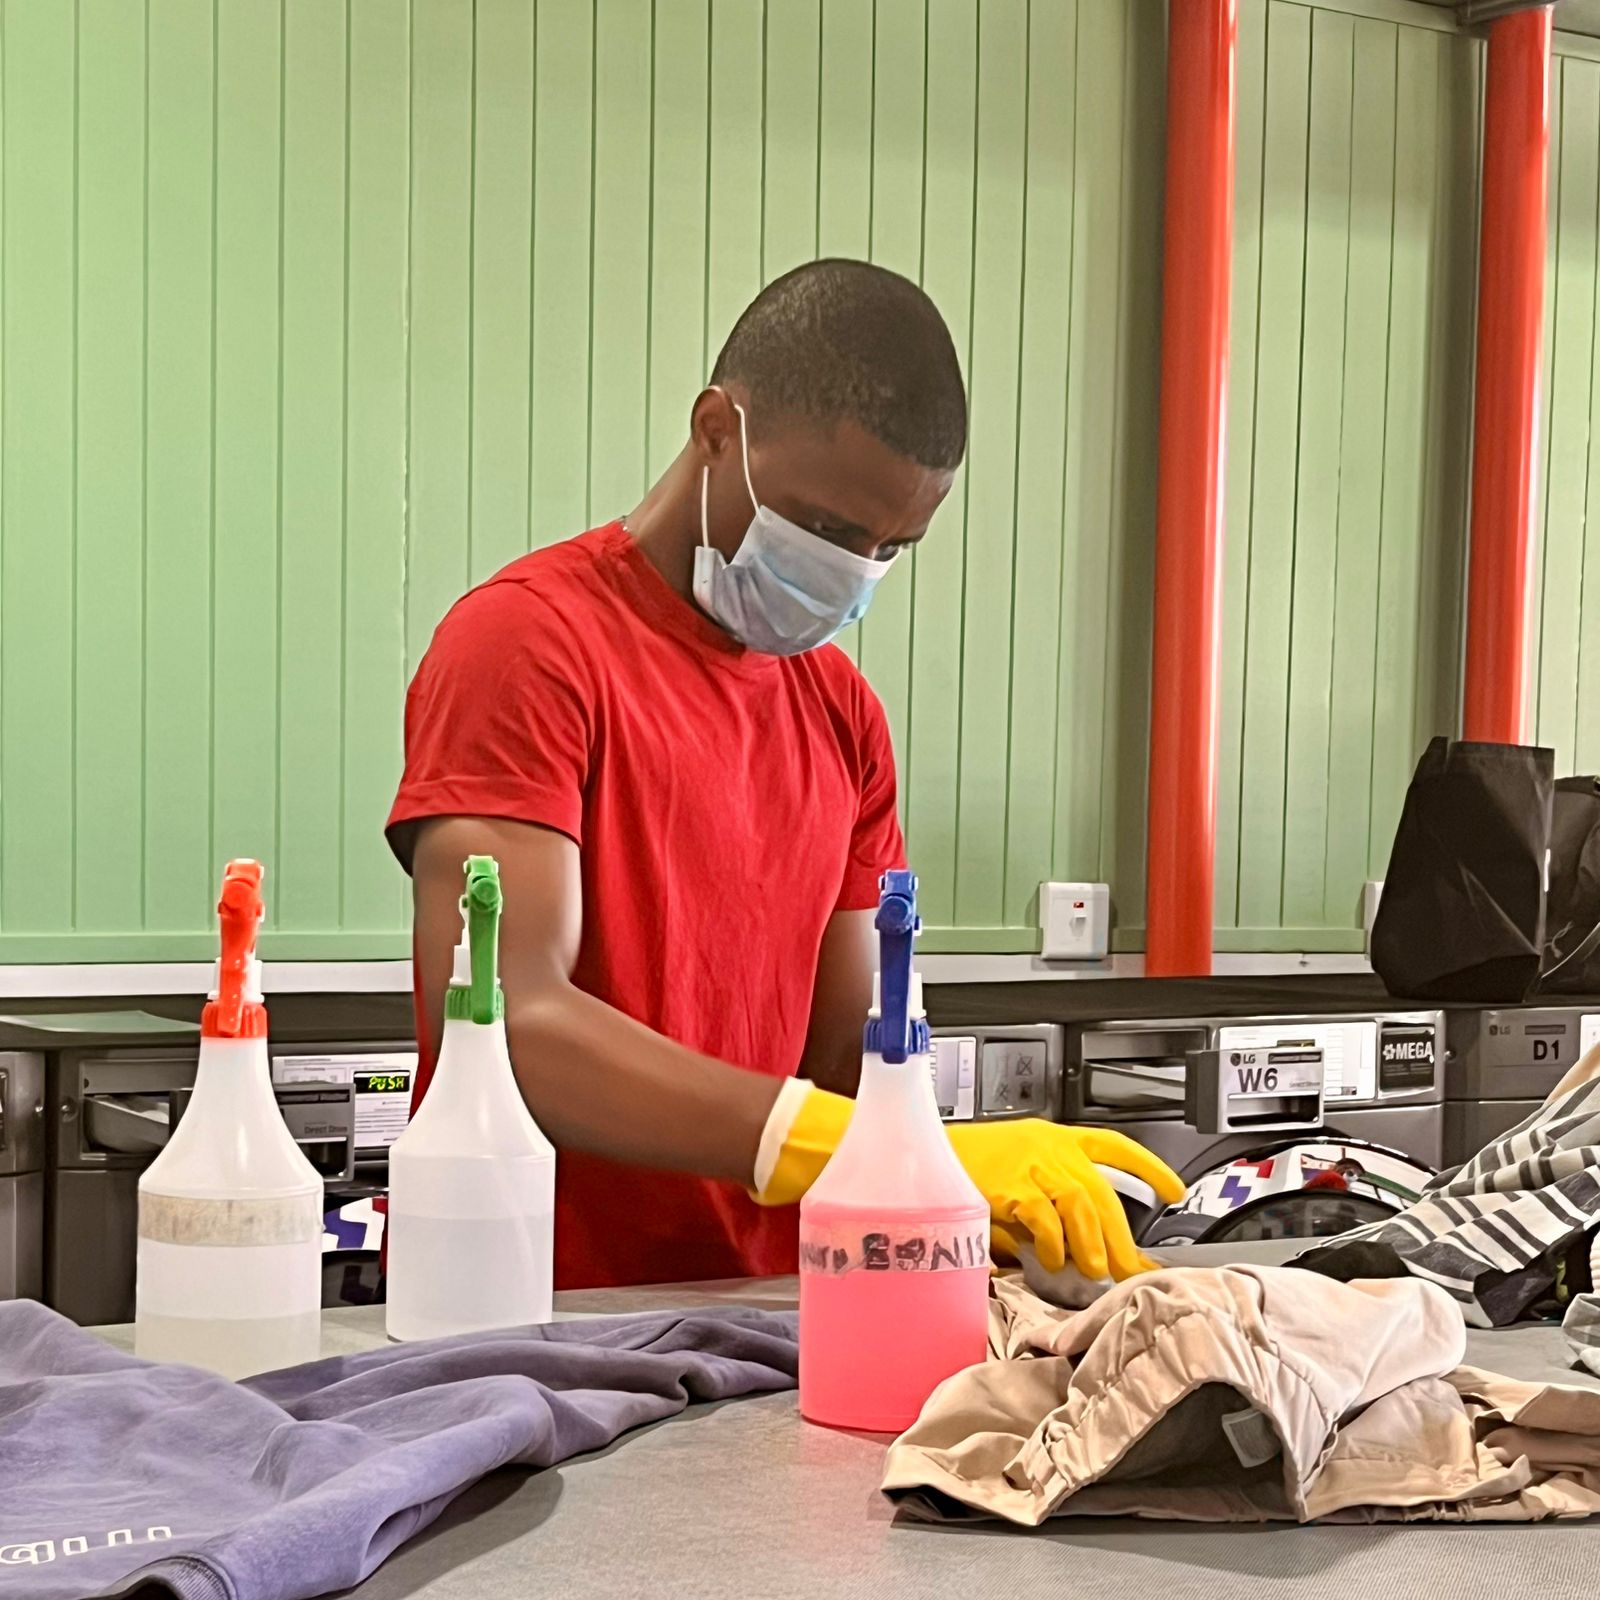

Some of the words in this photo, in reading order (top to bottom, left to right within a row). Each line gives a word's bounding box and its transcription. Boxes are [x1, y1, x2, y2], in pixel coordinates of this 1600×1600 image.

[1243, 1053, 1256, 1064] LG
[1533, 1040, 1560, 1061] D1
[368, 1075, 405, 1090] PUSH
[1237, 1067, 1279, 1093] W6
